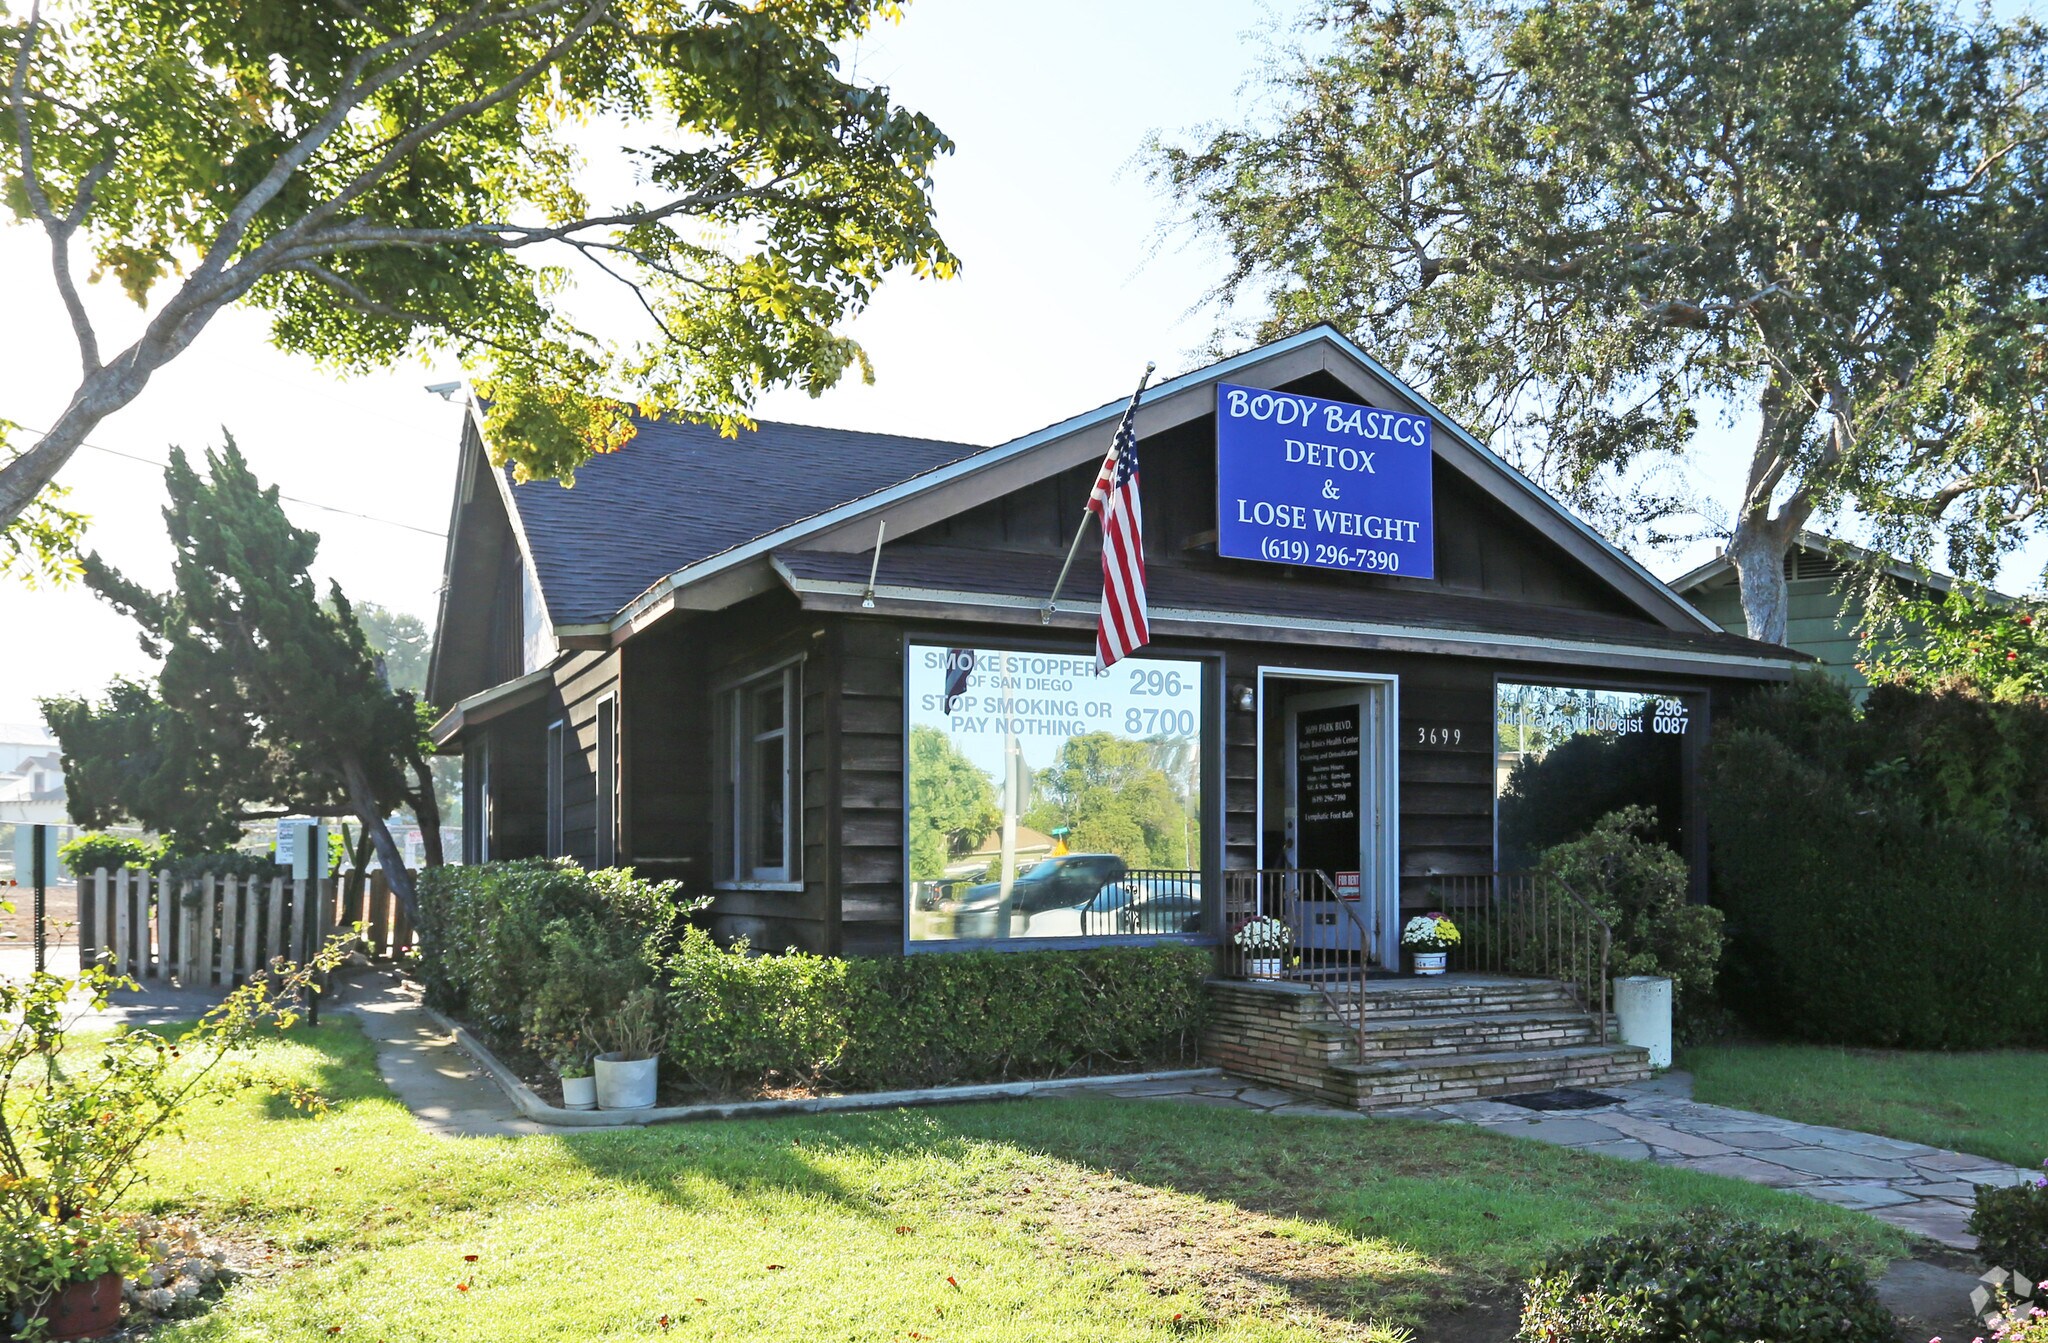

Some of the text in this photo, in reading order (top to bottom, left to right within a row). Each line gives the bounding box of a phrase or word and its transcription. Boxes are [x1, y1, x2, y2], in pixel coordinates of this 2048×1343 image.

[1227, 390, 1426, 447] BODY BASICS
[1284, 439, 1376, 474] DETOX
[1321, 478, 1341, 500] &
[1237, 499, 1420, 543] LOSE WEIGHT
[1261, 536, 1400, 572] (619) 296-7390
[924, 651, 1000, 672] SMOKE
[966, 674, 1073, 692] OF SAN DIEGO
[1129, 668, 1193, 697] 296-
[921, 693, 1112, 718] STOP SMOKING OR
[1655, 699, 1688, 717] 296-
[951, 716, 1086, 737] PAY NOTHING
[1124, 707, 1194, 736] 8700
[1319, 722, 1334, 732] PARK
[1335, 720, 1353, 731] BLVD.
[1553, 710, 1643, 736] Psychologist
[1652, 716, 1689, 735] 0087
[1342, 736, 1359, 744] Center
[1418, 727, 1461, 745] 3699
[1330, 811, 1341, 819] Foot
[1341, 810, 1354, 818] Bath
[1338, 875, 1359, 886] FOR RENT
